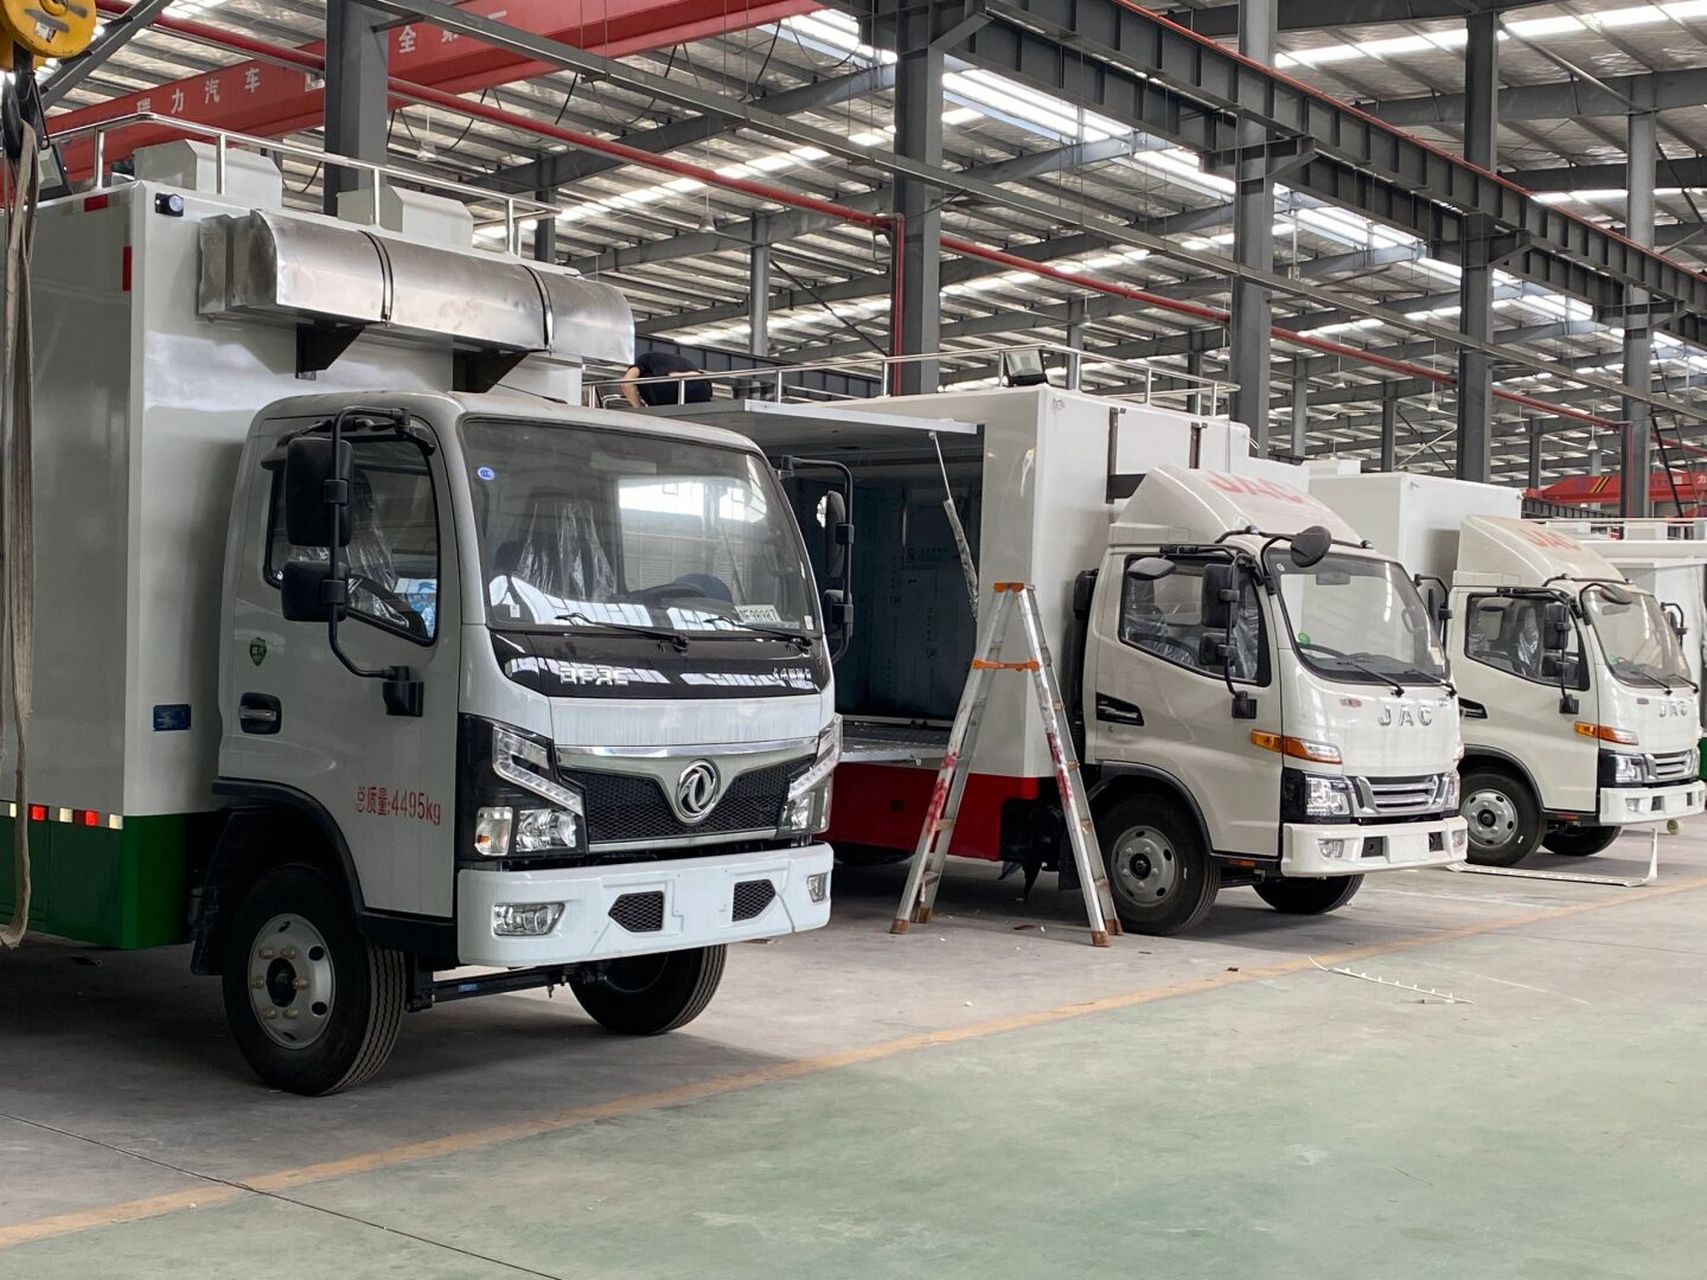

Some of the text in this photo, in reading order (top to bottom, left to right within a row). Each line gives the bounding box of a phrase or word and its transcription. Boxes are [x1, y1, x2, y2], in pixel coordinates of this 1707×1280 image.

[1207, 470, 1305, 504] JAC
[1378, 705, 1432, 726] JAC
[1659, 701, 1688, 717] JAC
